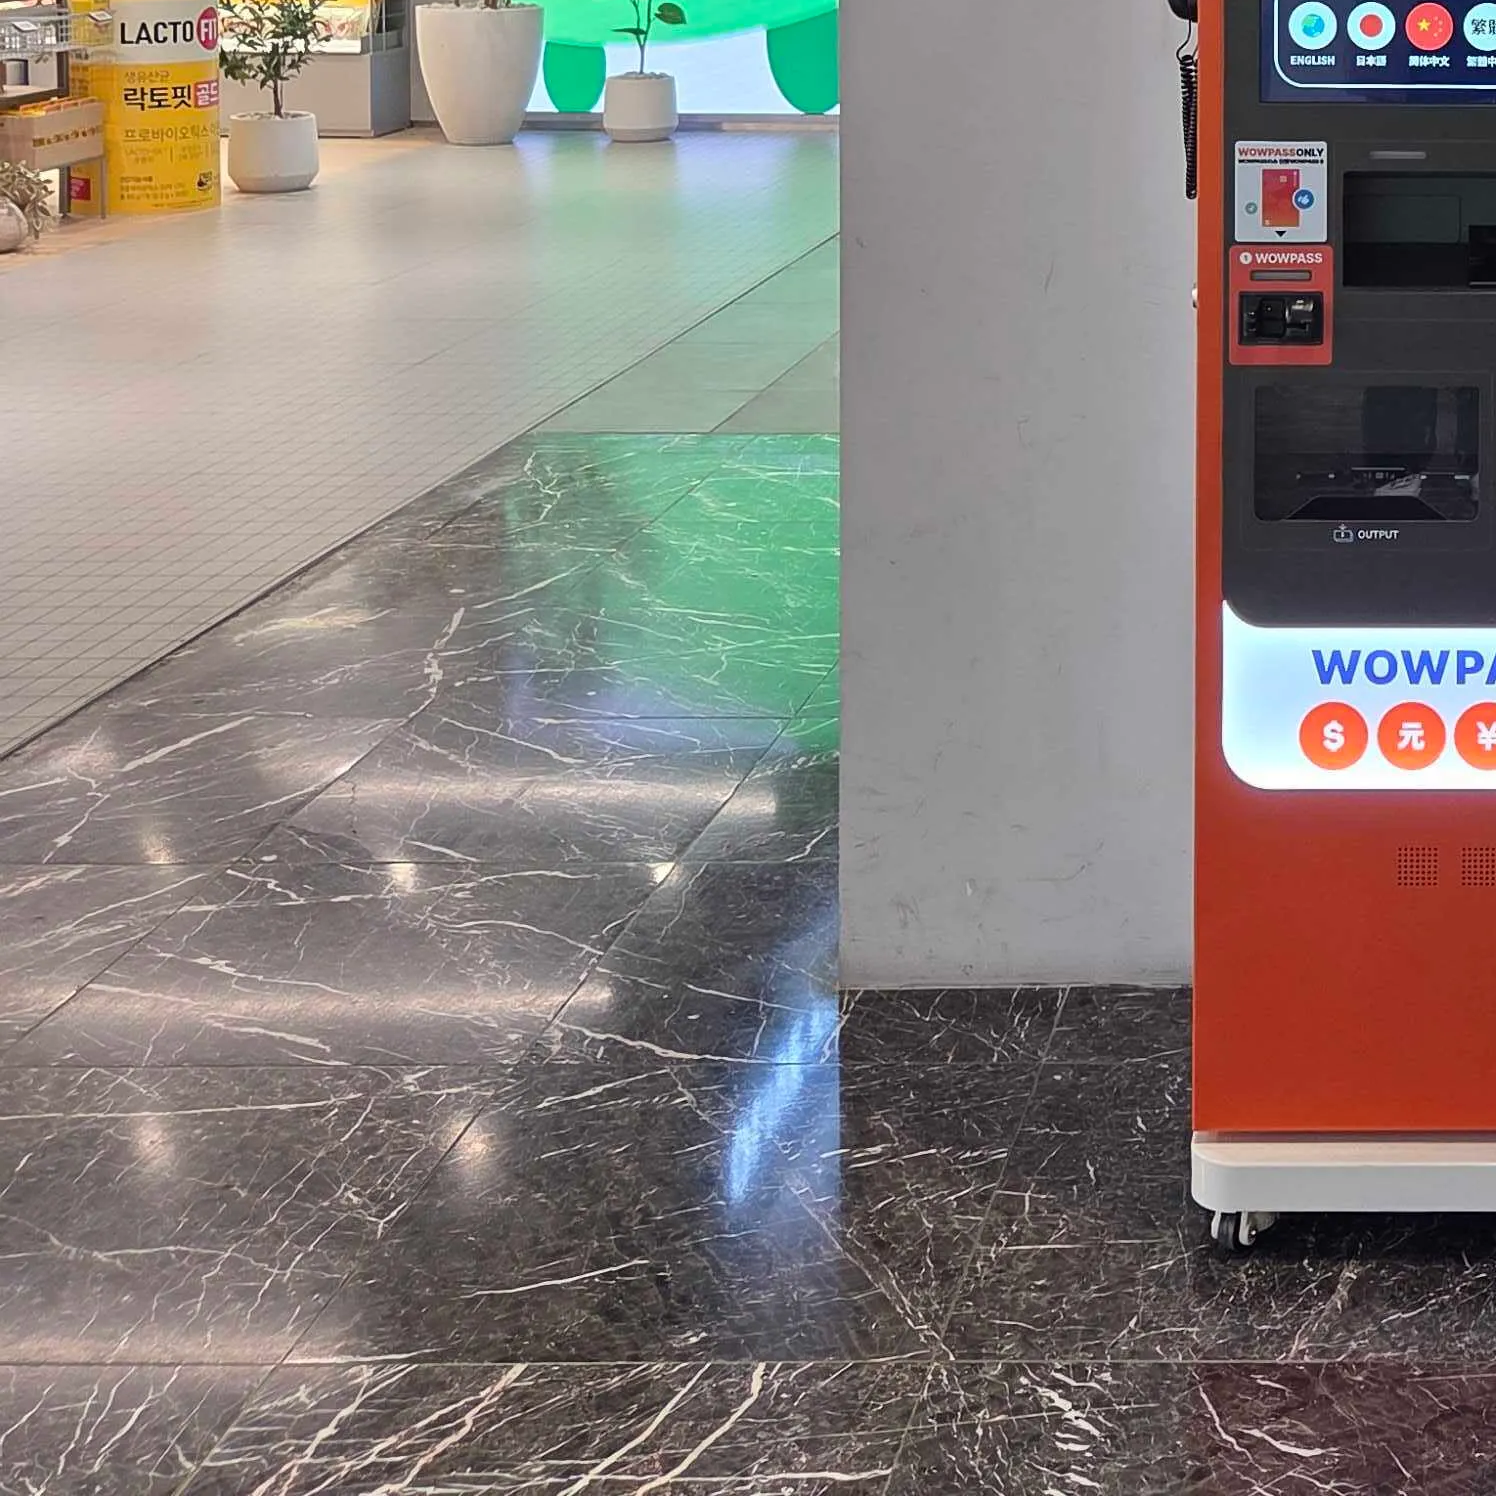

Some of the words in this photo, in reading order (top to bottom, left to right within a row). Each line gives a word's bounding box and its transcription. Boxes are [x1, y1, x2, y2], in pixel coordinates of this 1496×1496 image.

[120, 20, 194, 45] LACTO
[1290, 55, 1336, 66] ENGLISH
[1356, 55, 1388, 67] 日本語
[125, 70, 171, 84] 생유산균
[123, 84, 192, 111] 락토핏
[1255, 252, 1323, 264] WOWPASS
[1357, 529, 1399, 540] OUTPUT
[1397, 721, 1426, 752] 元
